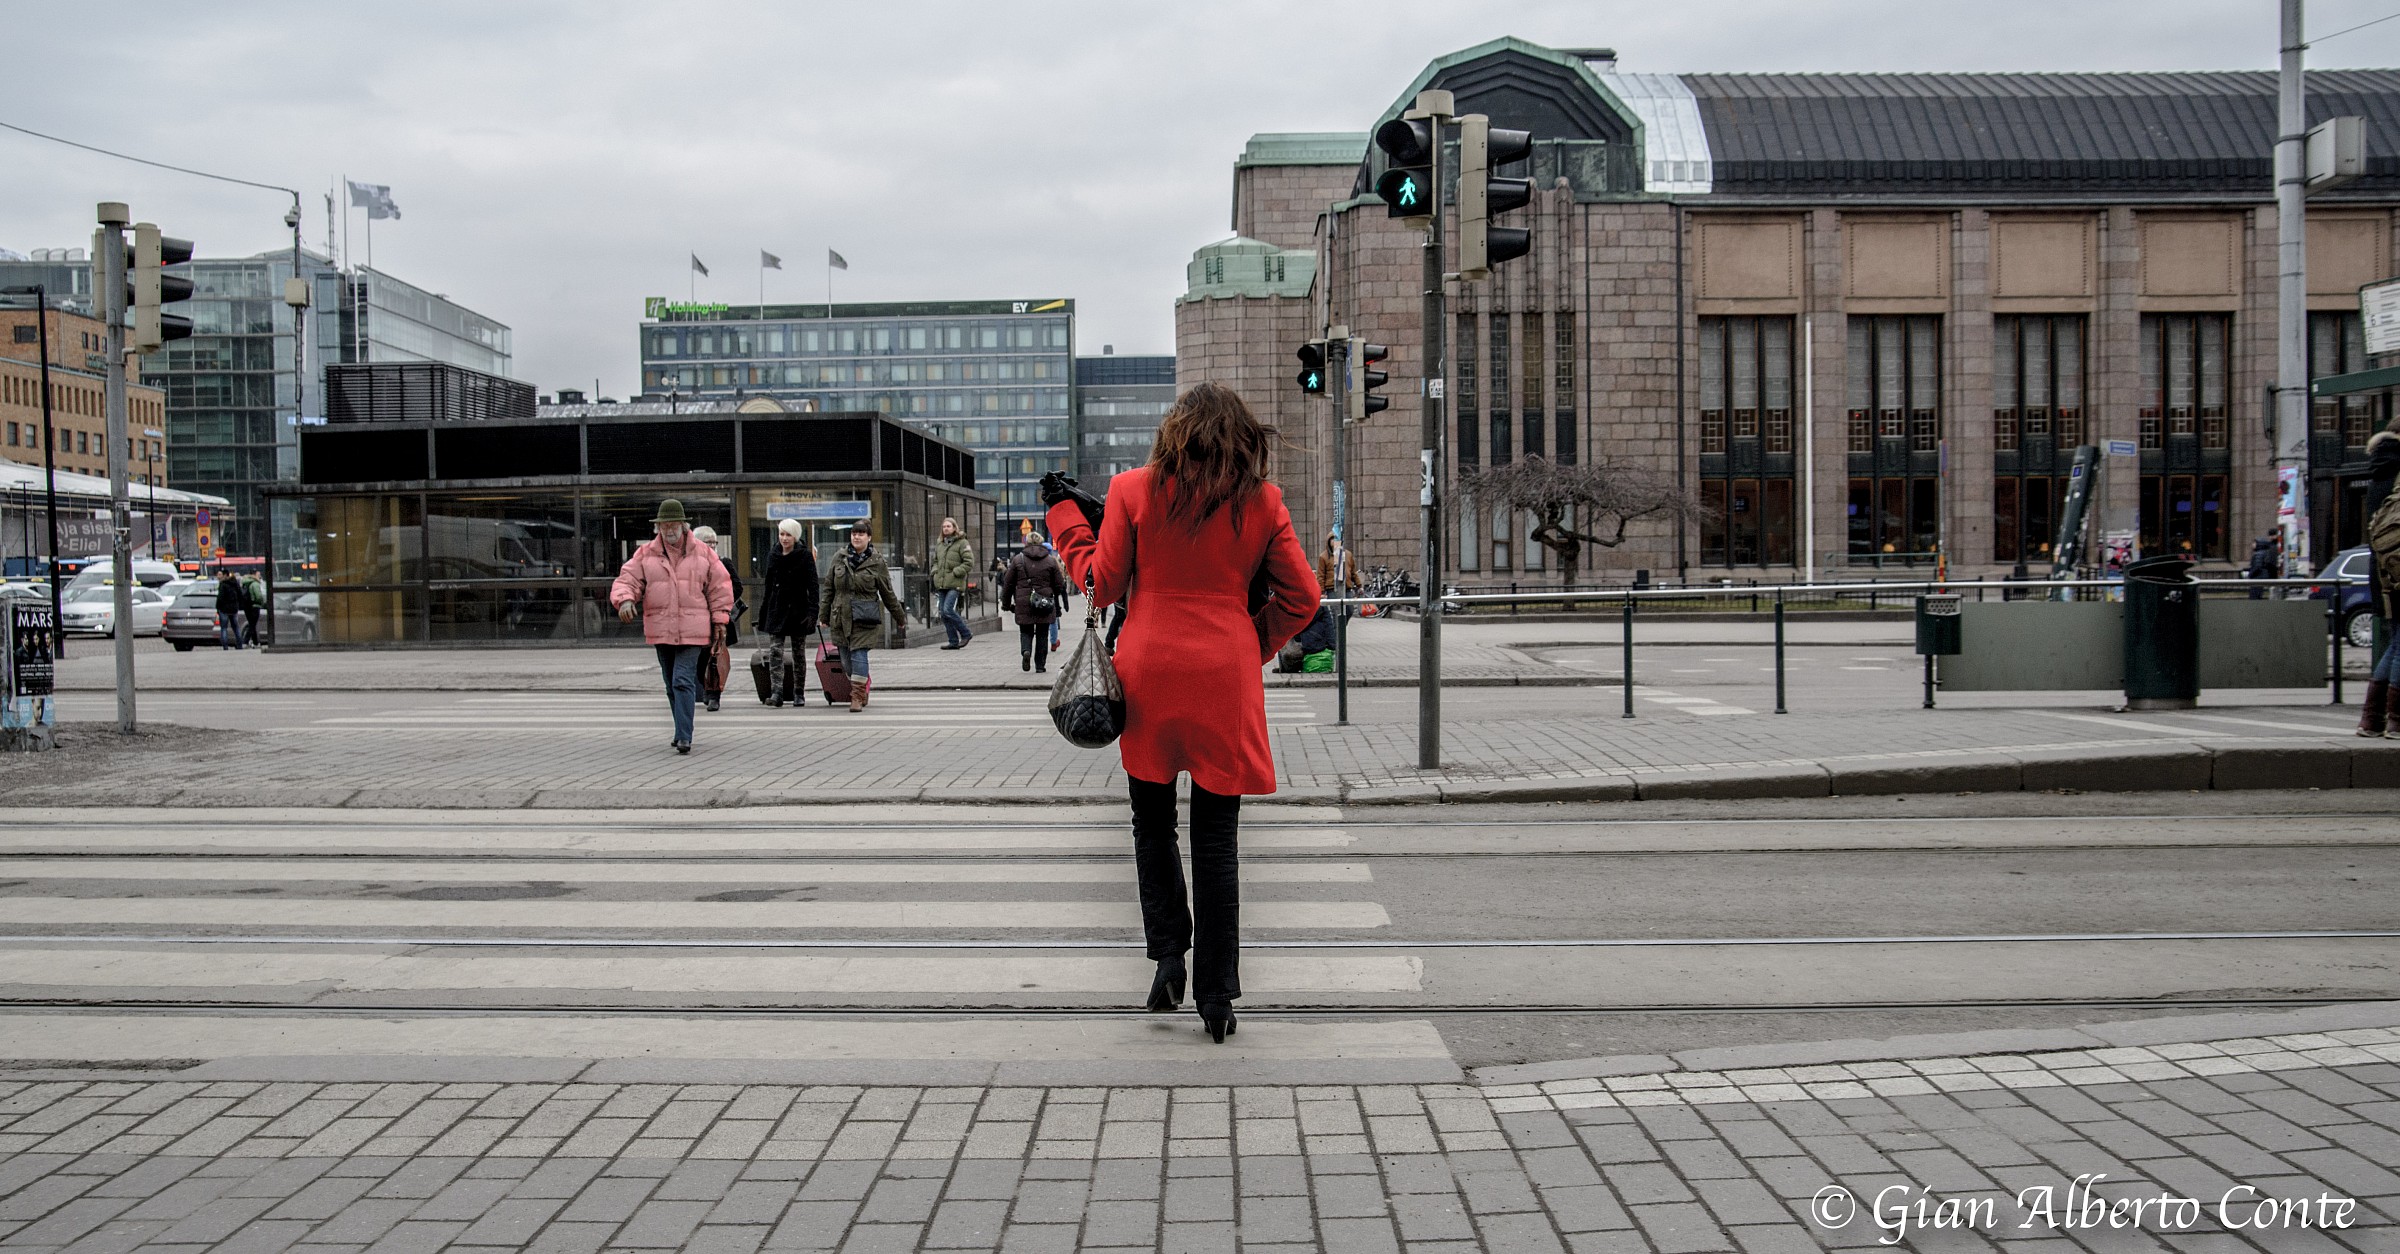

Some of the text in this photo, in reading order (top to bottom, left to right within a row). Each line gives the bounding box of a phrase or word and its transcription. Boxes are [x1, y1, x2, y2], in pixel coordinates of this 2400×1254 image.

[669, 301, 728, 315] Holiday Inn
[1012, 302, 1029, 313] EY
[81, 521, 113, 535] sisä
[155, 527, 163, 540] P
[17, 611, 53, 628] MARS
